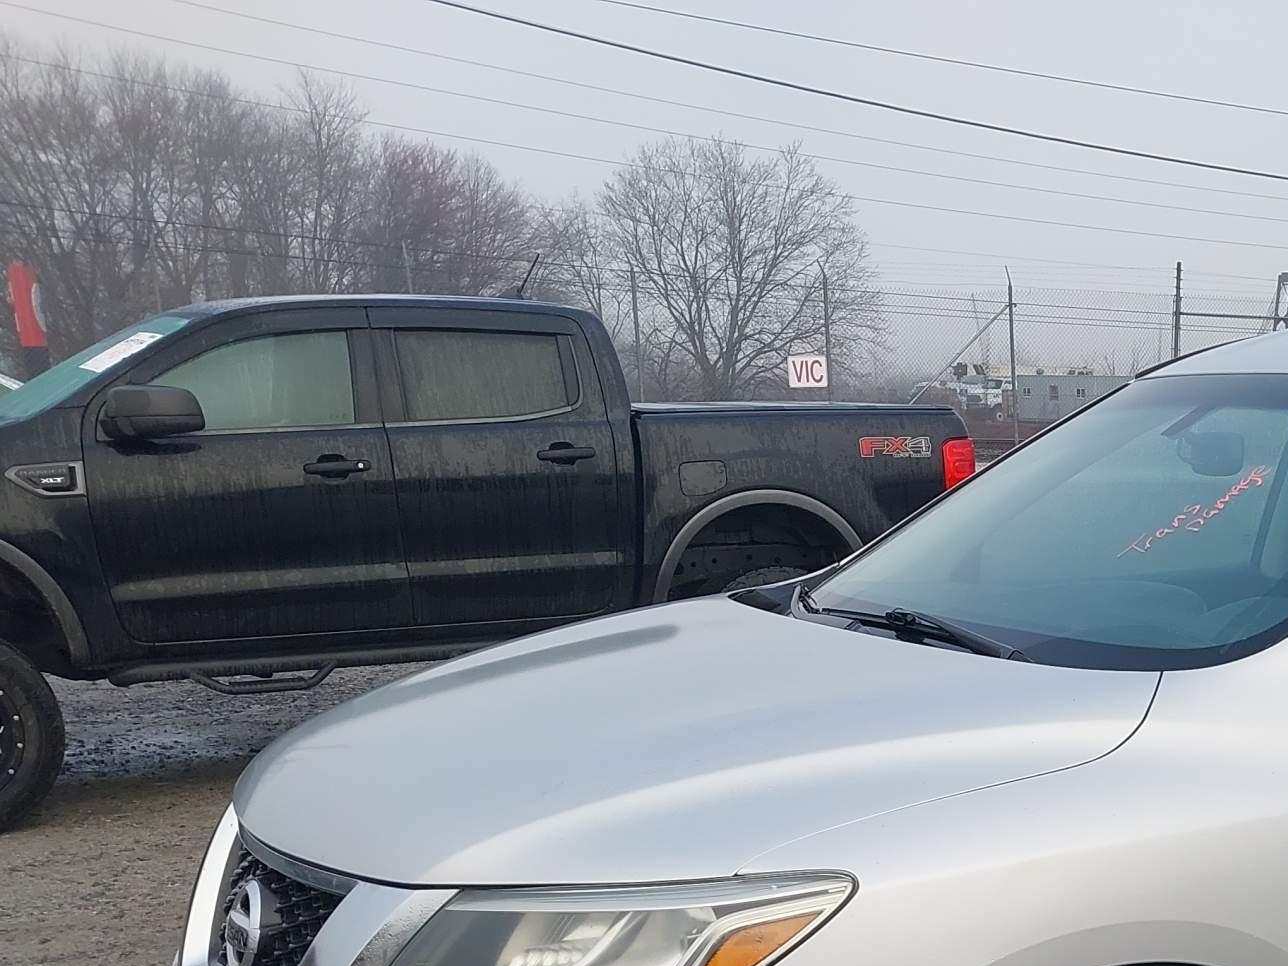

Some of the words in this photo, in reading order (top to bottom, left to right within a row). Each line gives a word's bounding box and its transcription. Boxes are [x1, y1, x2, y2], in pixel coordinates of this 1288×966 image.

[792, 360, 823, 383] VIC
[859, 436, 931, 457] FX4
[1185, 465, 1272, 531] Damage
[1114, 504, 1200, 558] Trans
